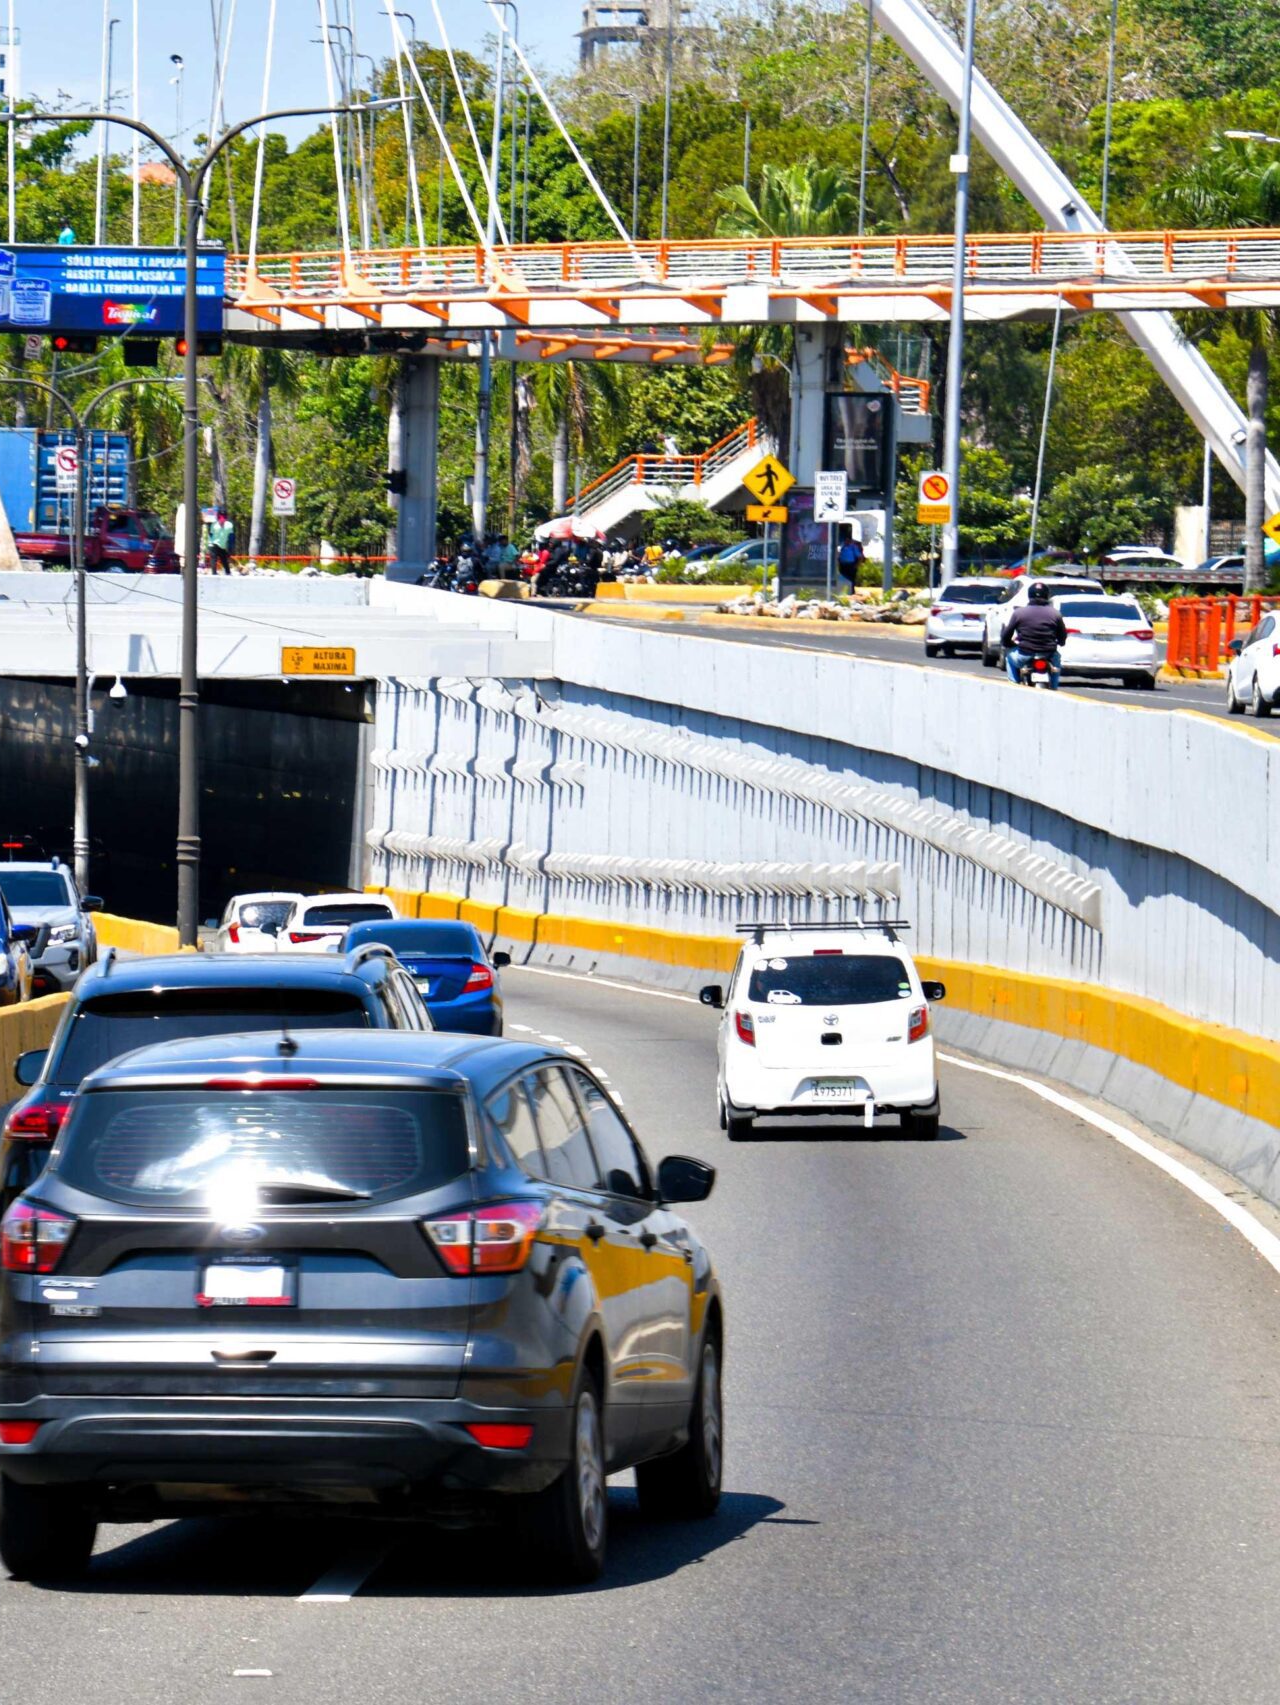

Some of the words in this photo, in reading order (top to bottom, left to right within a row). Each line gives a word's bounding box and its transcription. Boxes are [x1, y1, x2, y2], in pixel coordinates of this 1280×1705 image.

[93, 256, 140, 268] REQUIERE
[142, 257, 147, 267] 1
[66, 269, 106, 279] RESISTE
[107, 270, 134, 280] AGUA
[313, 652, 346, 660] ALTURA
[313, 663, 347, 671] MAXIMA
